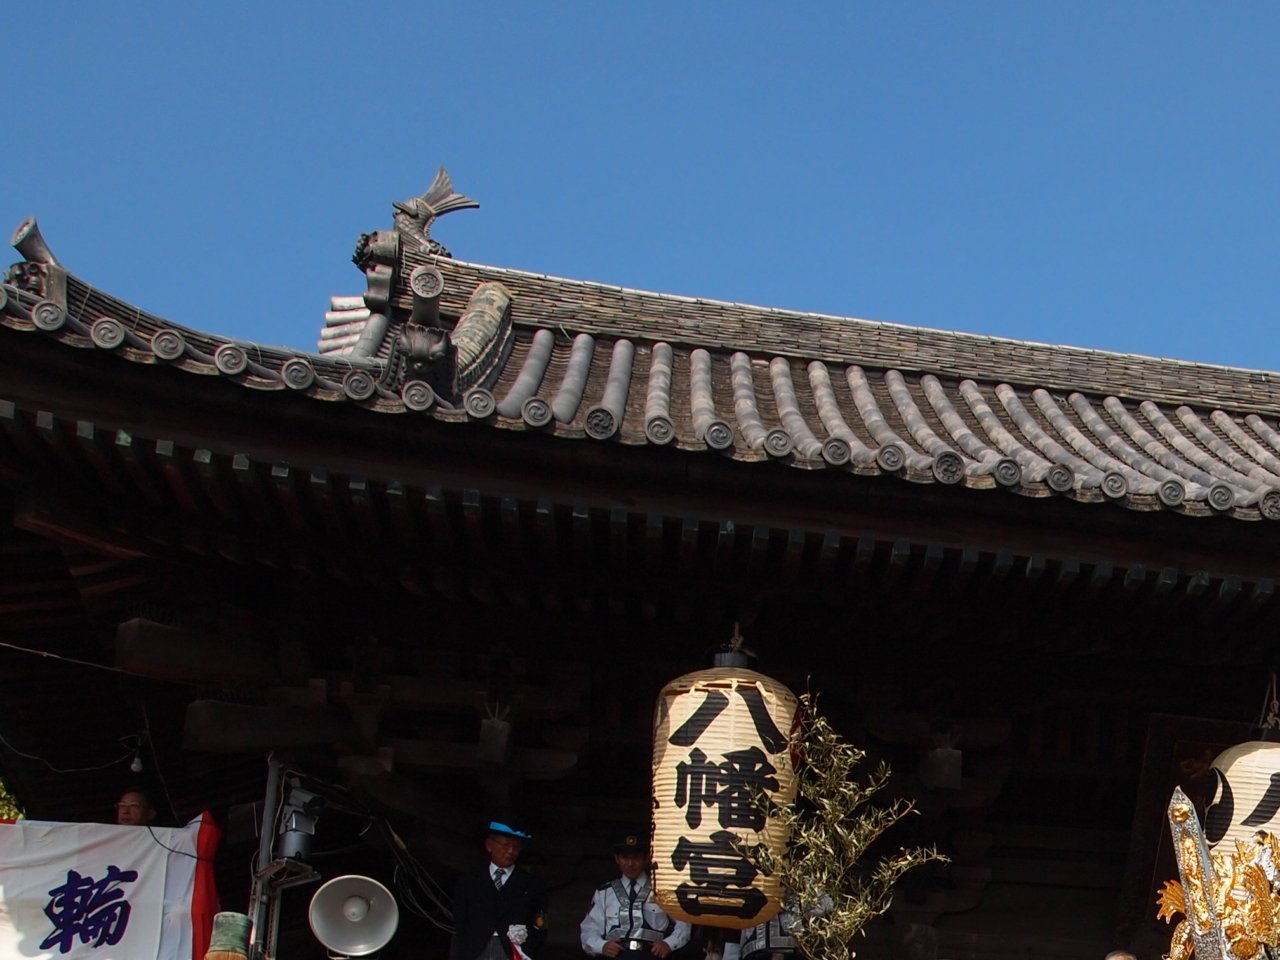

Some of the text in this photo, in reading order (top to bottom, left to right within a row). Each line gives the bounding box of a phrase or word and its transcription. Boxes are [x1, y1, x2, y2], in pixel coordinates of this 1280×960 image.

[669, 686, 788, 919] 八幡宮
[40, 865, 138, 954] 輪
